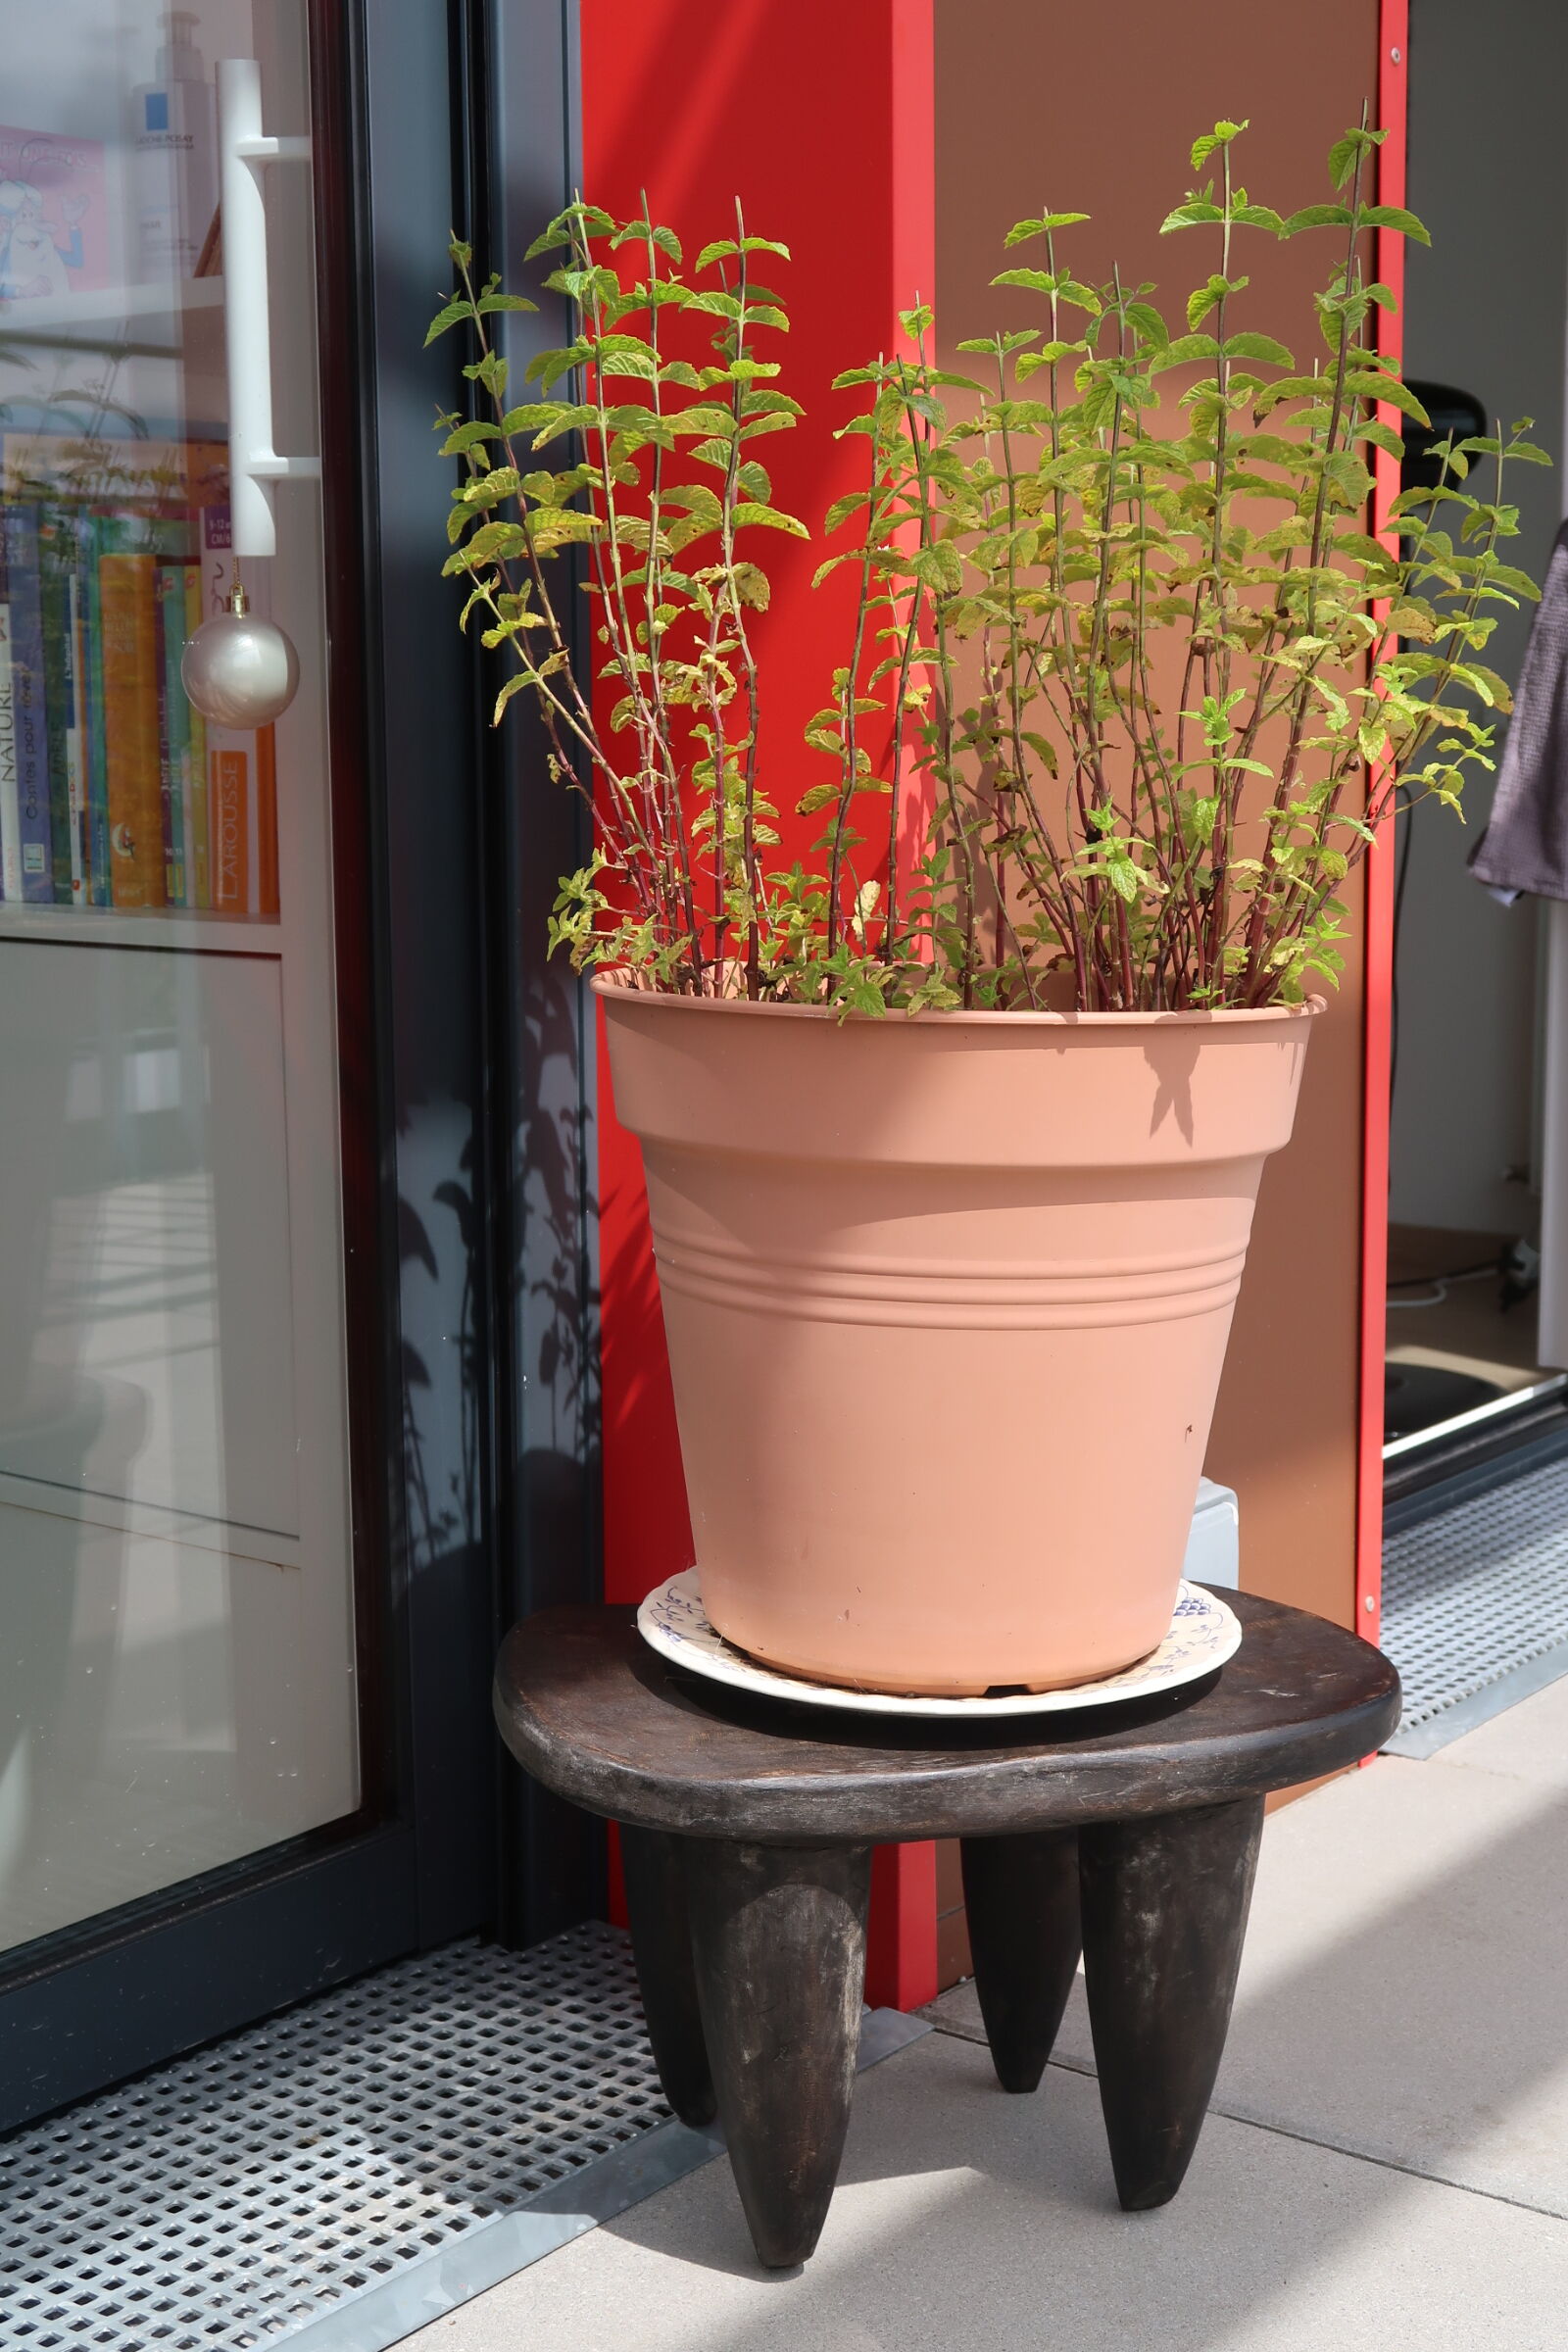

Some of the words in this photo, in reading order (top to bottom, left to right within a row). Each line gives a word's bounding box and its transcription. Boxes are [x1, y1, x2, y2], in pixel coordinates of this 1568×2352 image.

[0, 682, 16, 783] NATURE
[24, 716, 37, 755] pour
[24, 760, 37, 820] Contes
[220, 760, 238, 900] LAROUSSE
